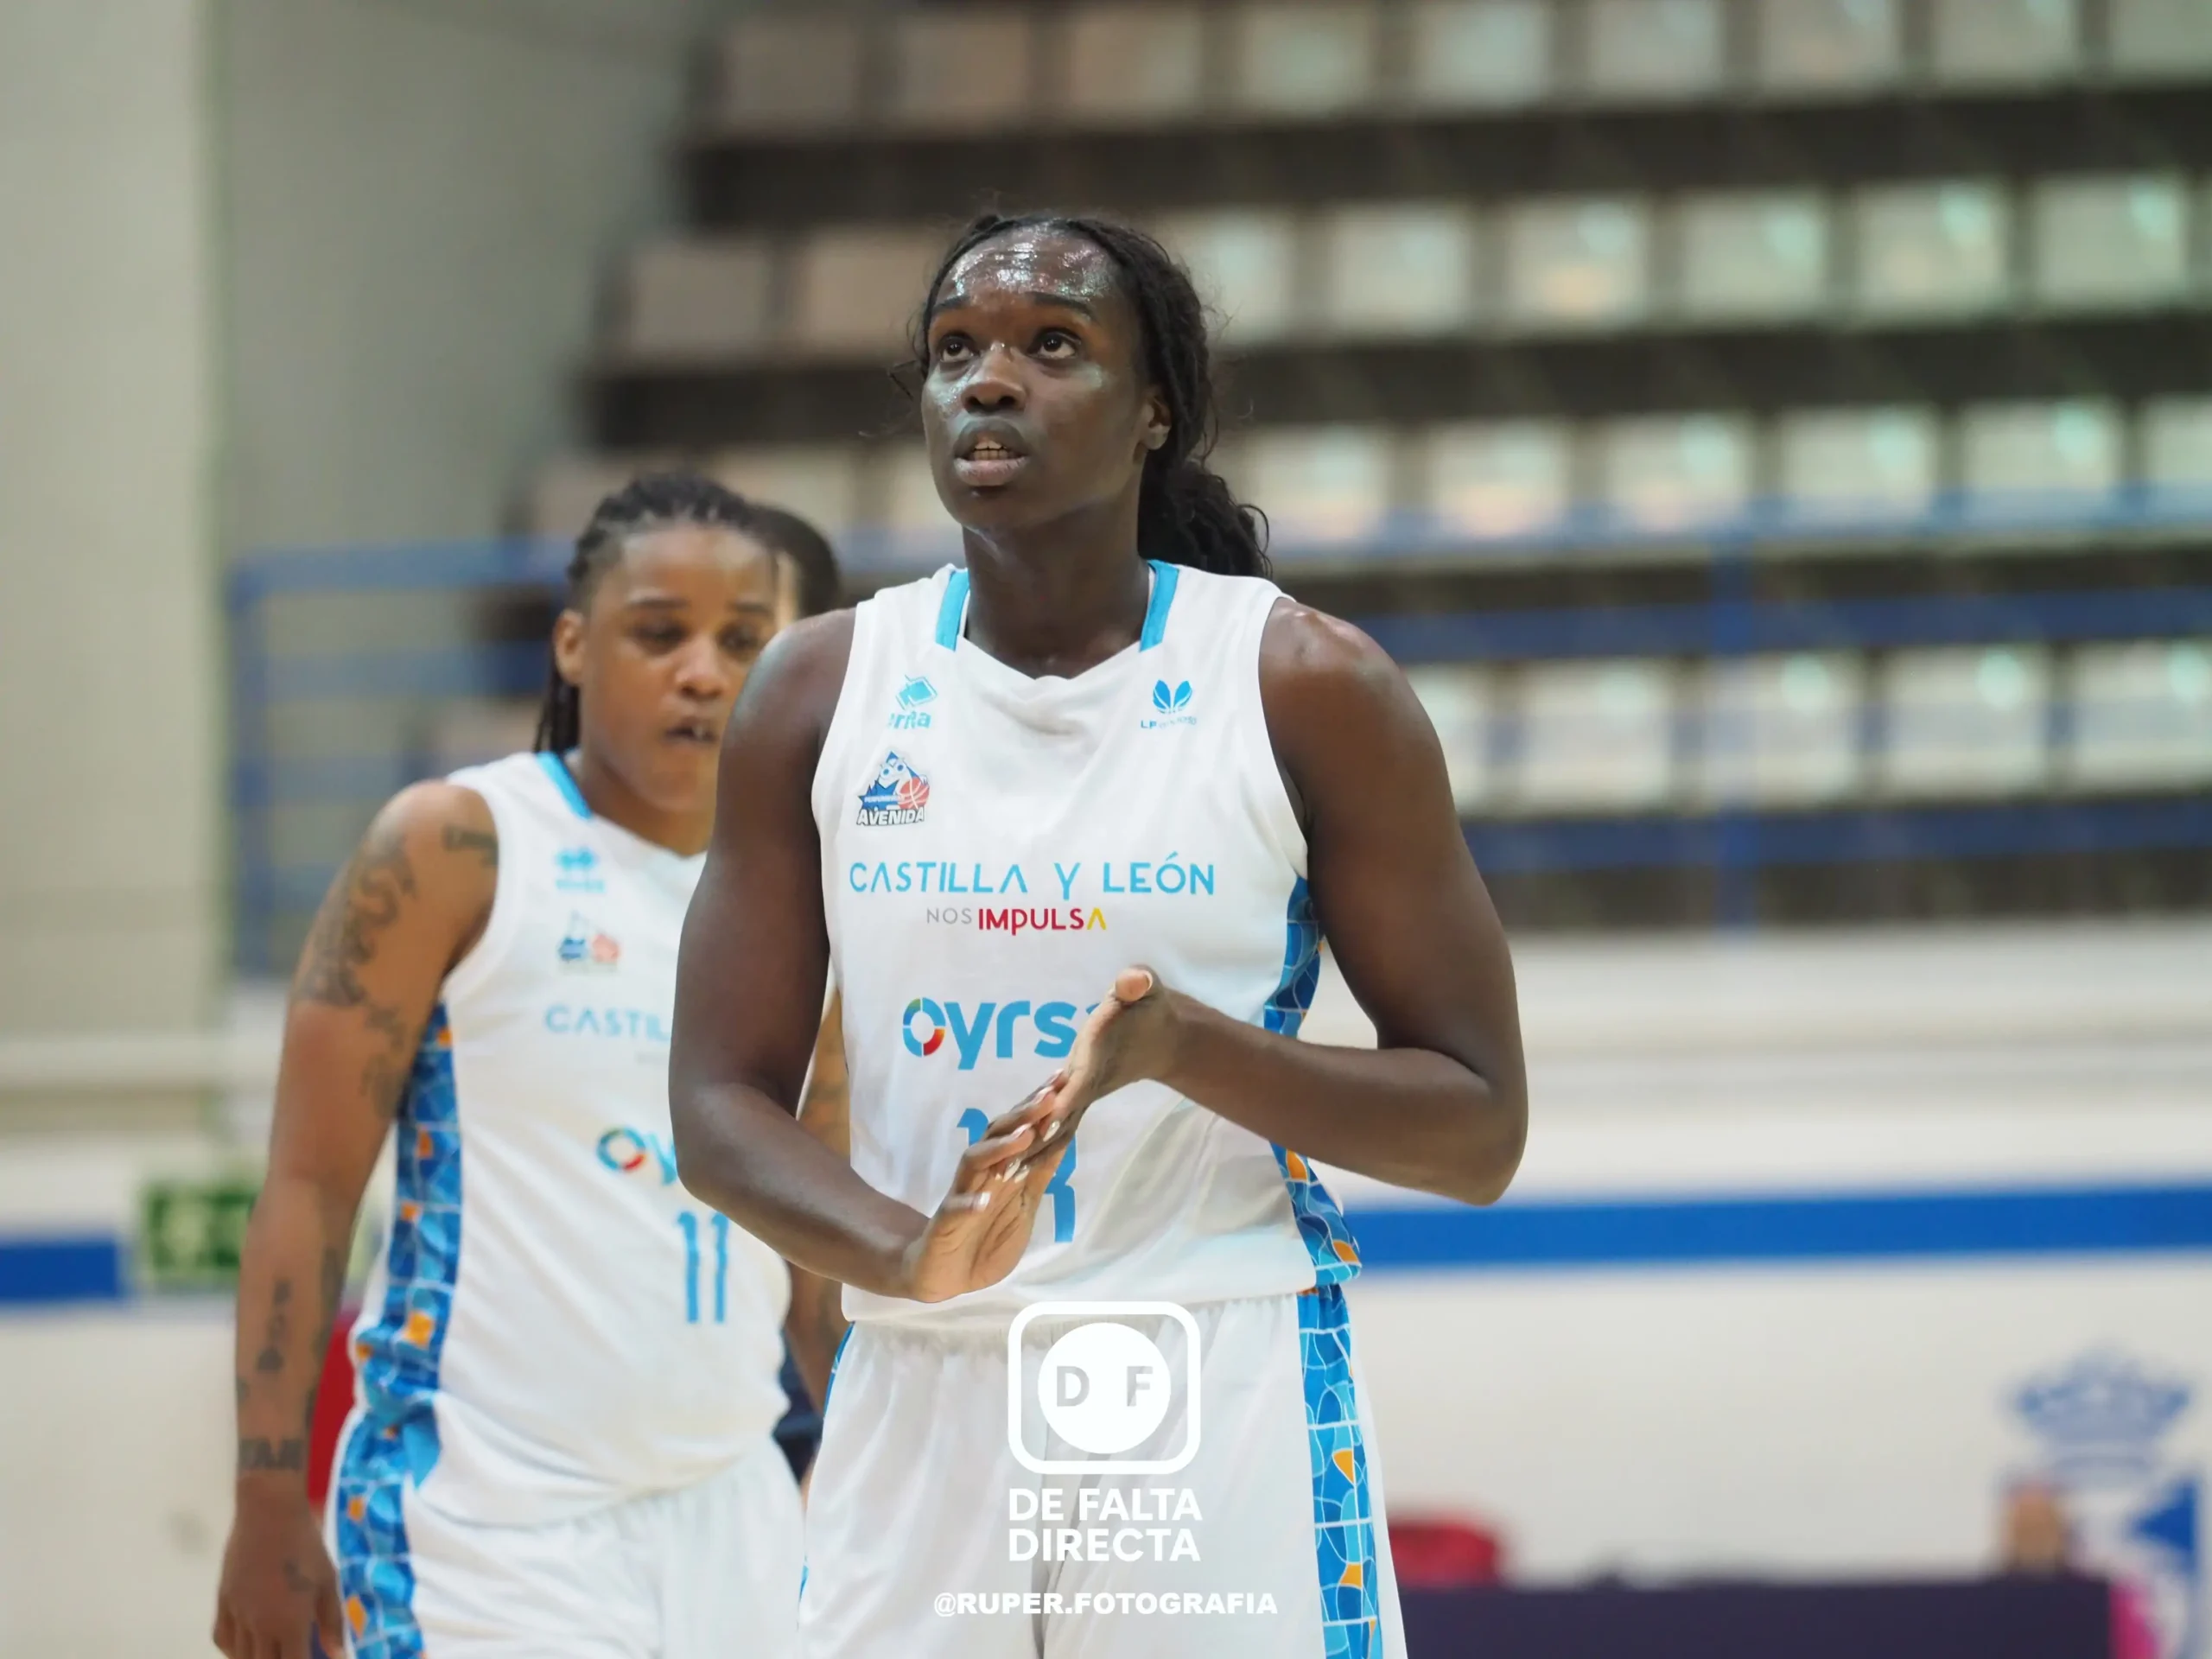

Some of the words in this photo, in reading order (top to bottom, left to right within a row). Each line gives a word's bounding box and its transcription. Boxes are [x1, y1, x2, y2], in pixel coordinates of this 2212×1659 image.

[856, 806, 925, 826] AVENIDA
[849, 861, 1028, 893] CASTILLA
[1054, 861, 1082, 900] Y
[1103, 851, 1215, 895] LEÓN
[926, 908, 972, 925] NOS
[978, 907, 1107, 936] IMPULSA
[544, 1003, 671, 1042] CASTIL
[676, 1210, 729, 1324] 11
